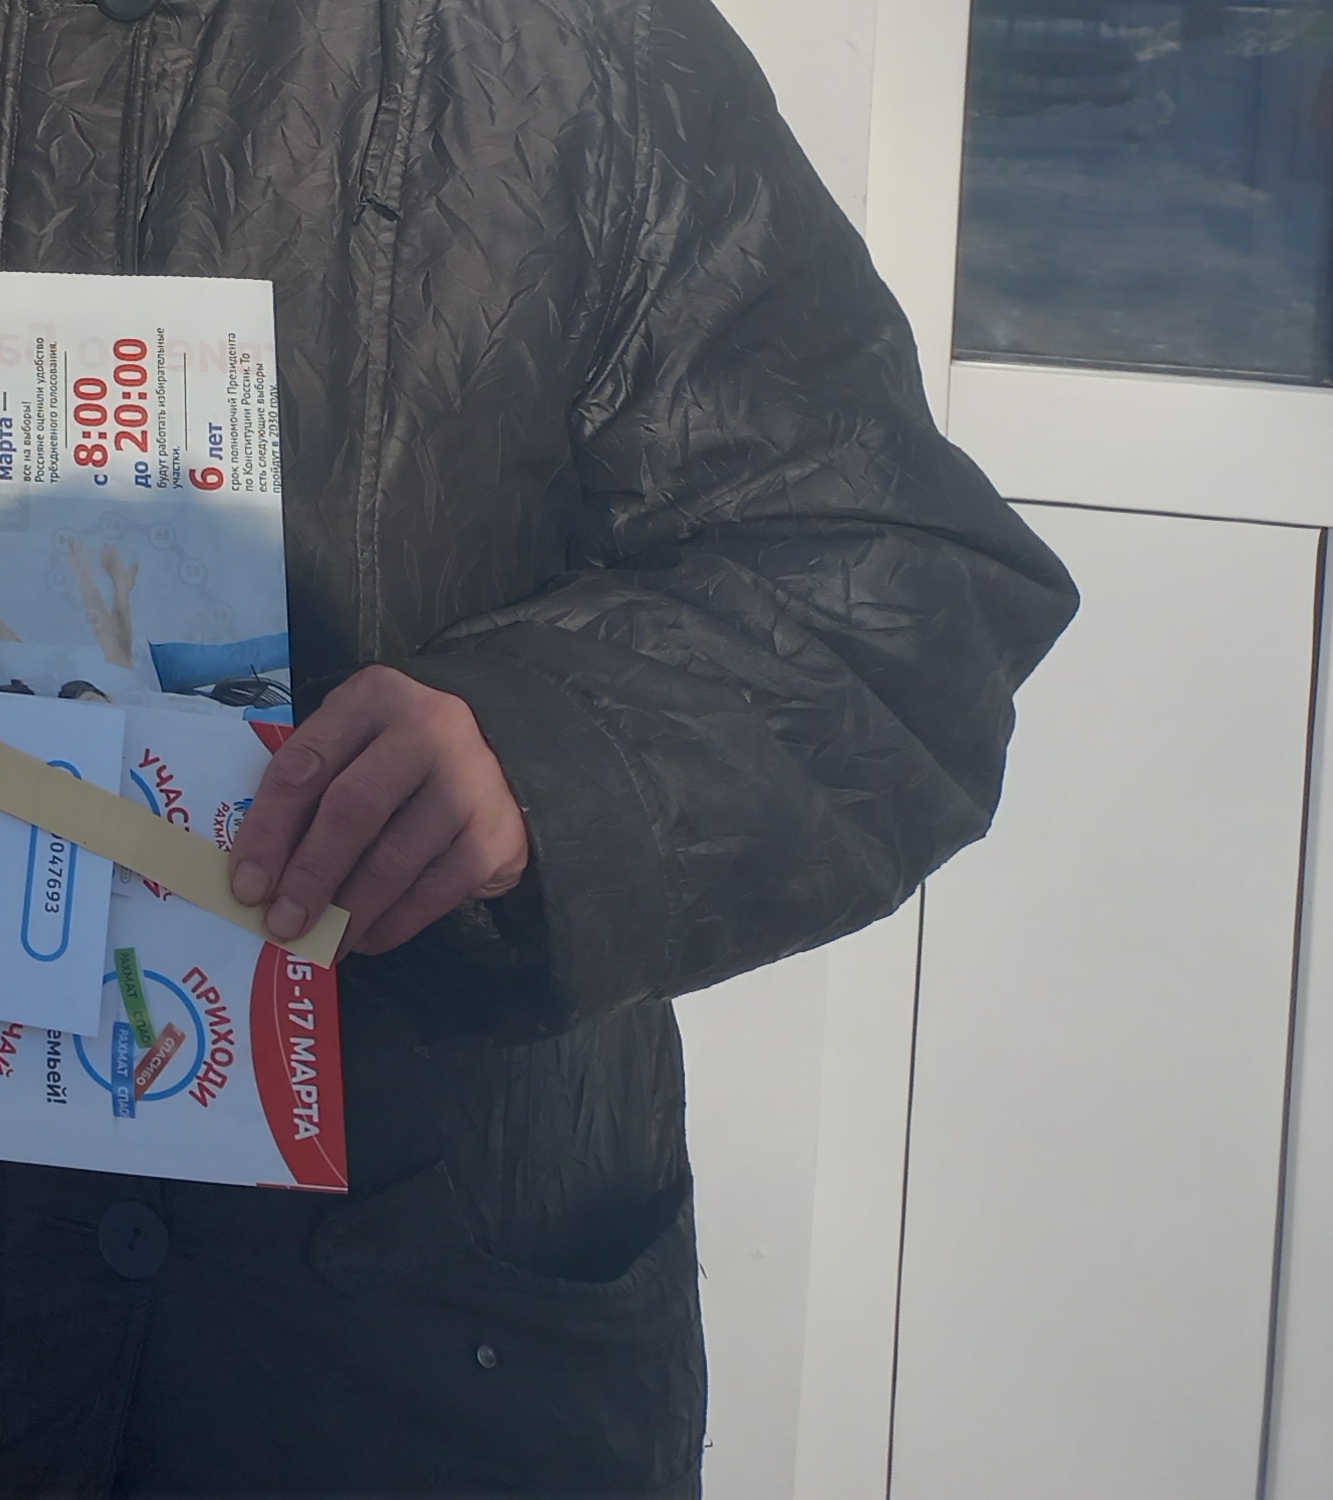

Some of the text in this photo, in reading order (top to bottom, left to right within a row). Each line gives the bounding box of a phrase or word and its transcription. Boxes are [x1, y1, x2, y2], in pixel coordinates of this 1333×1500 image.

[0, 417, 16, 481] марта
[21, 401, 33, 482] все на выборы!
[34, 338, 46, 483] Россияне оценили удобство
[48, 342, 60, 484] трёхдневного голосования.
[73, 377, 108, 486] с 8:00
[113, 338, 152, 489] до 20:00
[155, 327, 169, 489] будут работать избирательные
[188, 422, 224, 491] 6 лет
[226, 332, 240, 491] срок полномочий Президента
[239, 353, 254, 491] по Конституции России. То
[254, 363, 268, 492] есть следующие выборы
[268, 411, 279, 438] 2030
[171, 446, 183, 489] участки.
[270, 450, 282, 493] пройдут
[120, 952, 138, 999] РАХМАТ
[117, 1029, 129, 1077] РАХМАТ
[136, 1037, 175, 1086] СПАСИБО
[181, 966, 235, 1108] ПРИХОДИ
[289, 1037, 321, 1140] МАРТА
